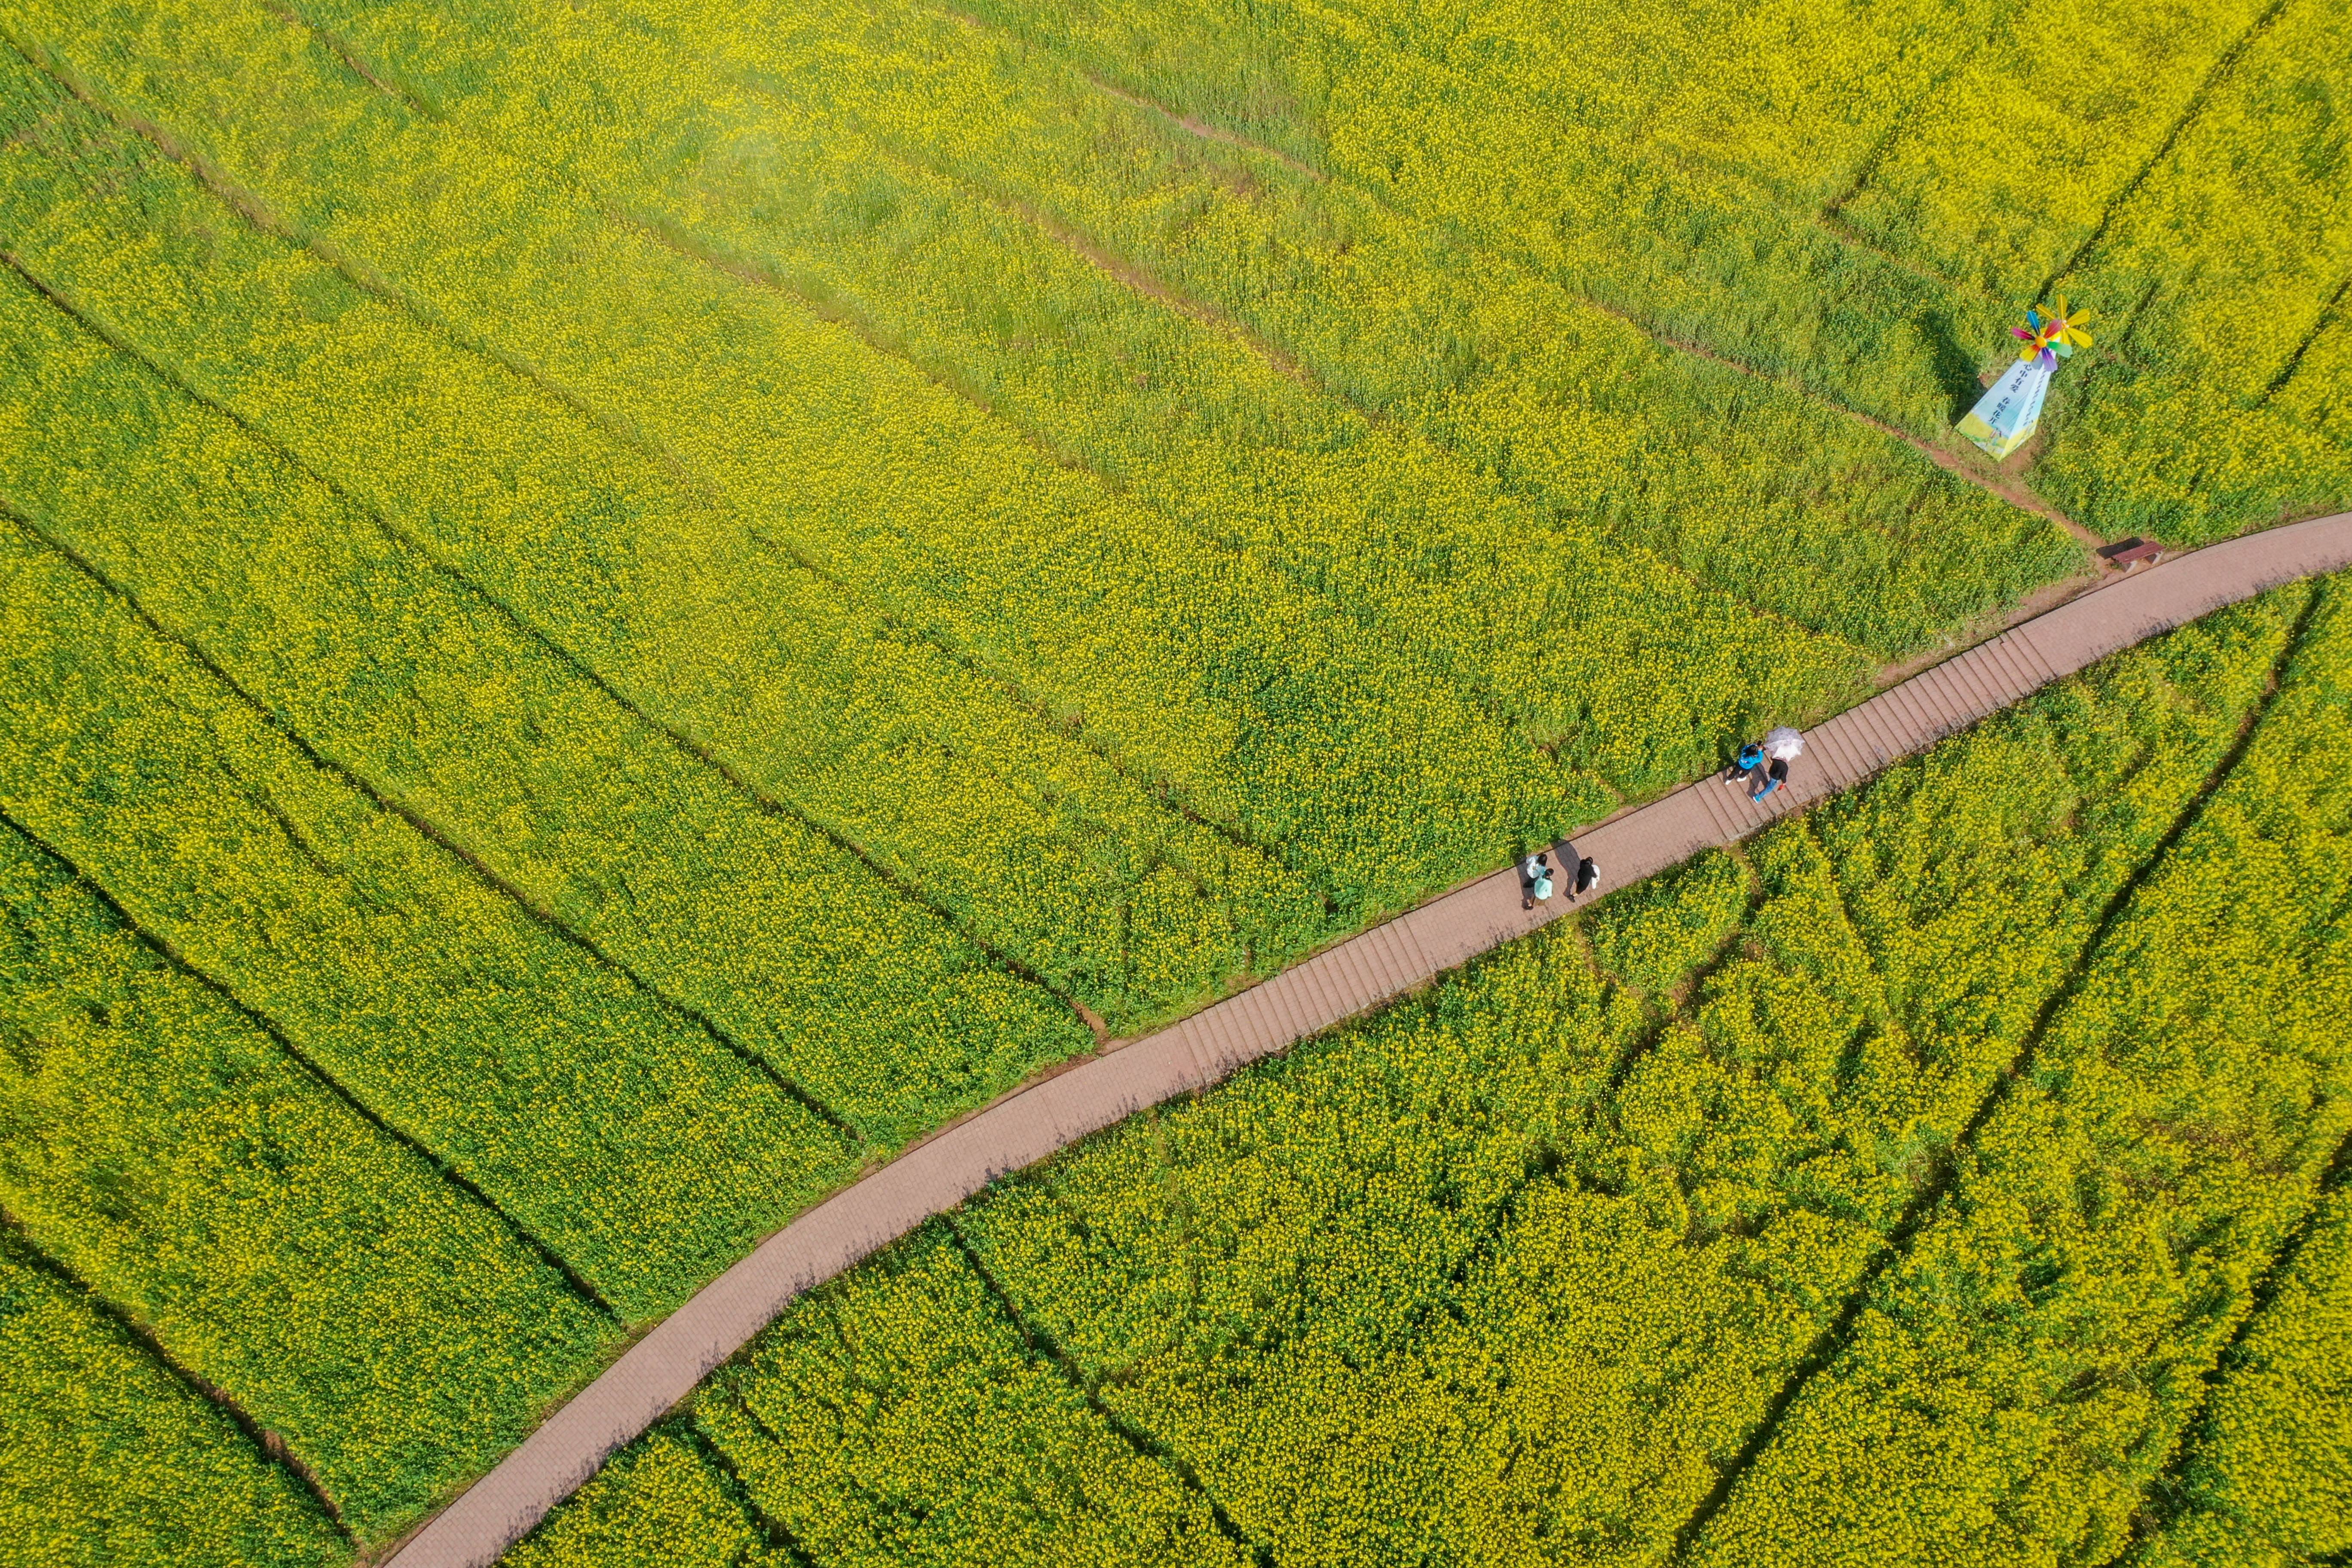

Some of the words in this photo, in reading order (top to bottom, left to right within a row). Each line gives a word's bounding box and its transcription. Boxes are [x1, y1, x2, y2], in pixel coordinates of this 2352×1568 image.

[2010, 364, 2032, 393] 心中有爱
[1988, 396, 2010, 424] 春暖花开
